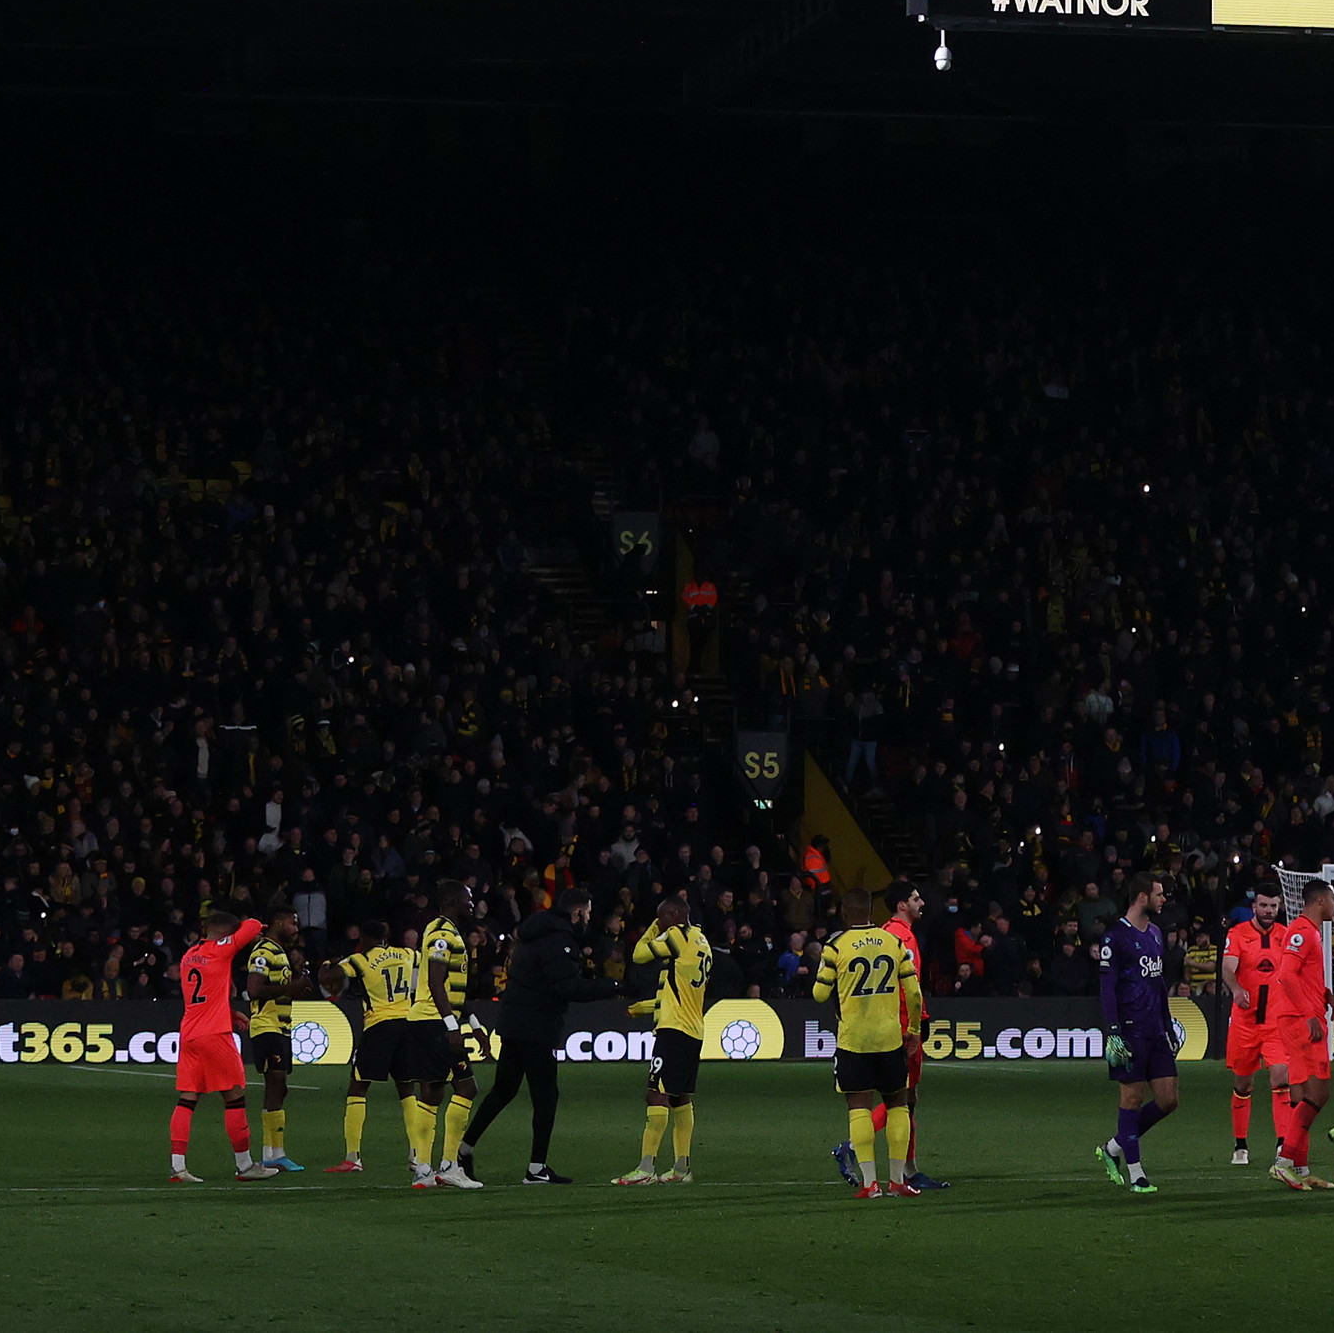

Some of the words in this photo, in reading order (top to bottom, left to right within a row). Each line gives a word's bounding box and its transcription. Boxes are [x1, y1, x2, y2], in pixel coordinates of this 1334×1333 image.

[744, 752, 780, 779] S5
[852, 938, 883, 950] SAMIR
[370, 951, 403, 970] HASSANE
[849, 955, 895, 996] 22
[188, 968, 206, 1003] 2
[381, 967, 409, 1002] 14
